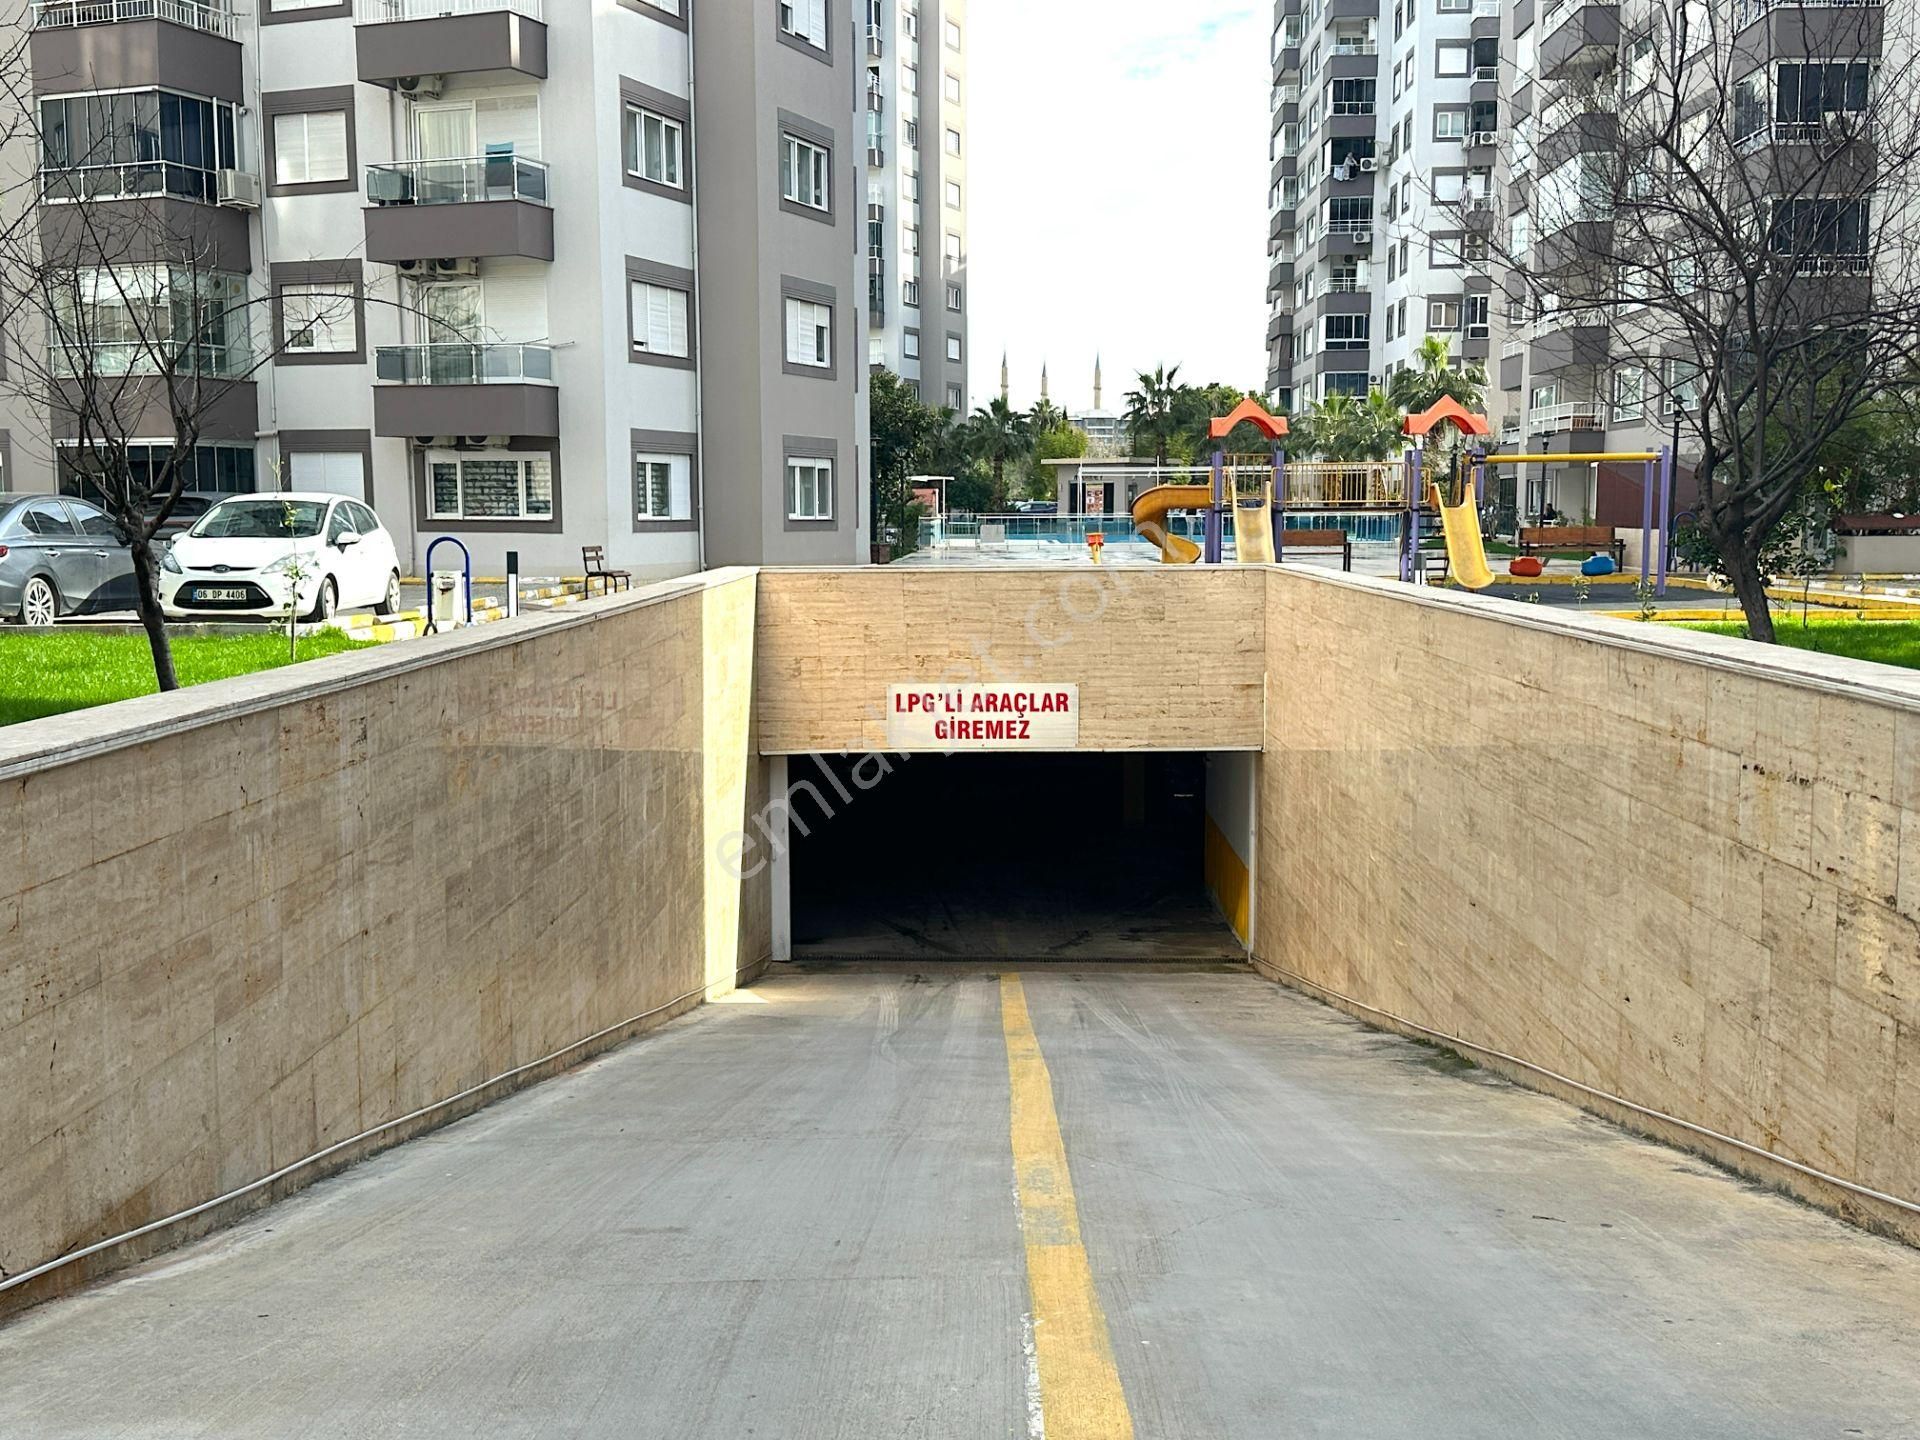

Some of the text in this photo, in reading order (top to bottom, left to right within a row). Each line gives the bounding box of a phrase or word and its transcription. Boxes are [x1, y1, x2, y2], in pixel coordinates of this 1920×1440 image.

[197, 590, 246, 599] 06 DP 4406
[895, 689, 1069, 718] LPG'Lİ ARAÇLAR
[934, 715, 1030, 740] GİREMEZ
